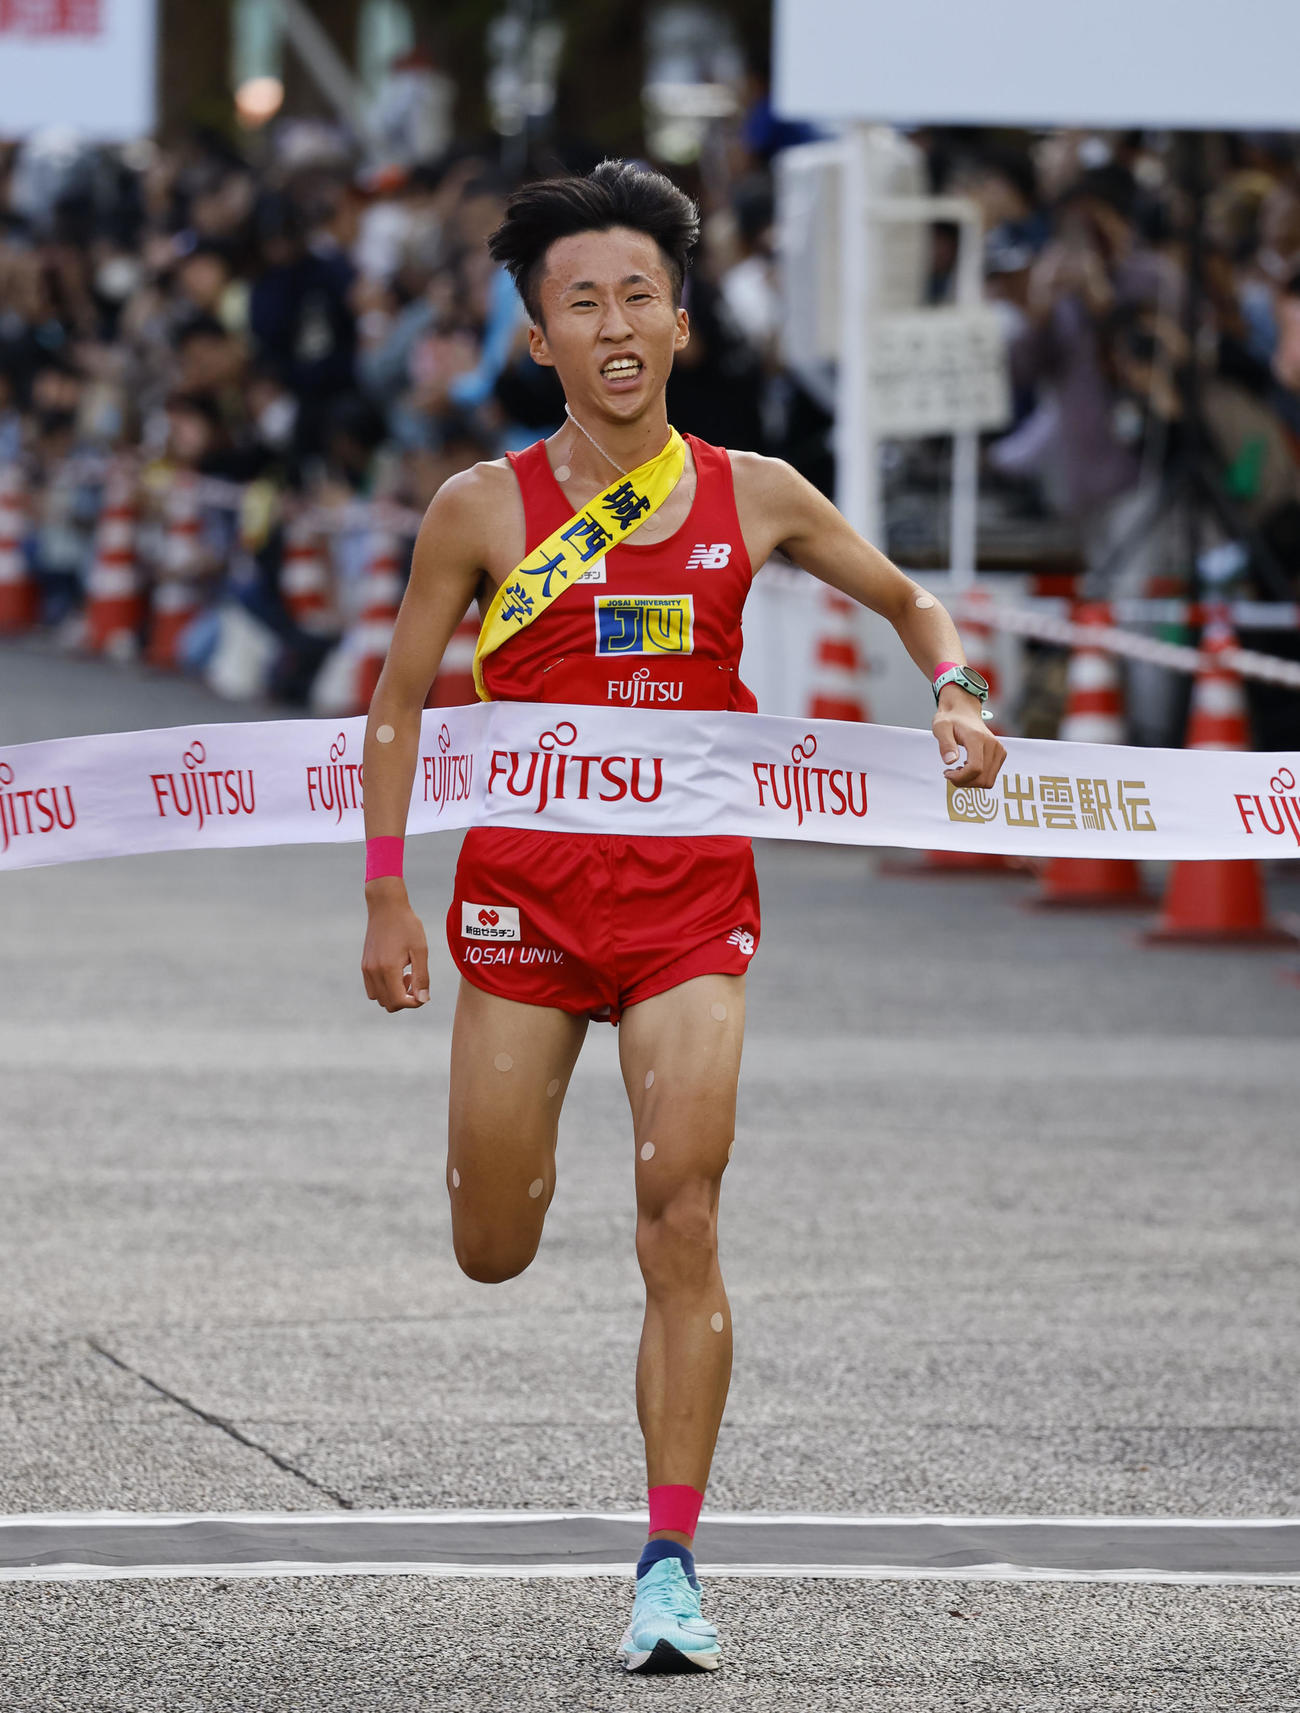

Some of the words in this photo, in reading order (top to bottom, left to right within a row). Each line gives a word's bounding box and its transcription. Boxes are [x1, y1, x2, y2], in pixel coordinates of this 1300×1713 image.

[500, 481, 651, 625] 城西大学
[607, 599, 632, 607] JOSAI
[634, 599, 682, 607] UNIVERSITY
[607, 608, 683, 652] JU
[607, 680, 683, 707] FUJITSU
[150, 769, 256, 831] FUJITSU
[306, 764, 364, 826] FUJIT
[422, 753, 473, 816] FUJITSU
[488, 749, 663, 814] FUJITSU
[752, 761, 868, 826] FUJITSU
[1002, 773, 1157, 832] 出雲駅伝
[0, 785, 77, 854] JITSU
[463, 945, 515, 965] JOSAI
[519, 946, 564, 965] UNIV.
[465, 925, 515, 938] 新田ゼラチン
